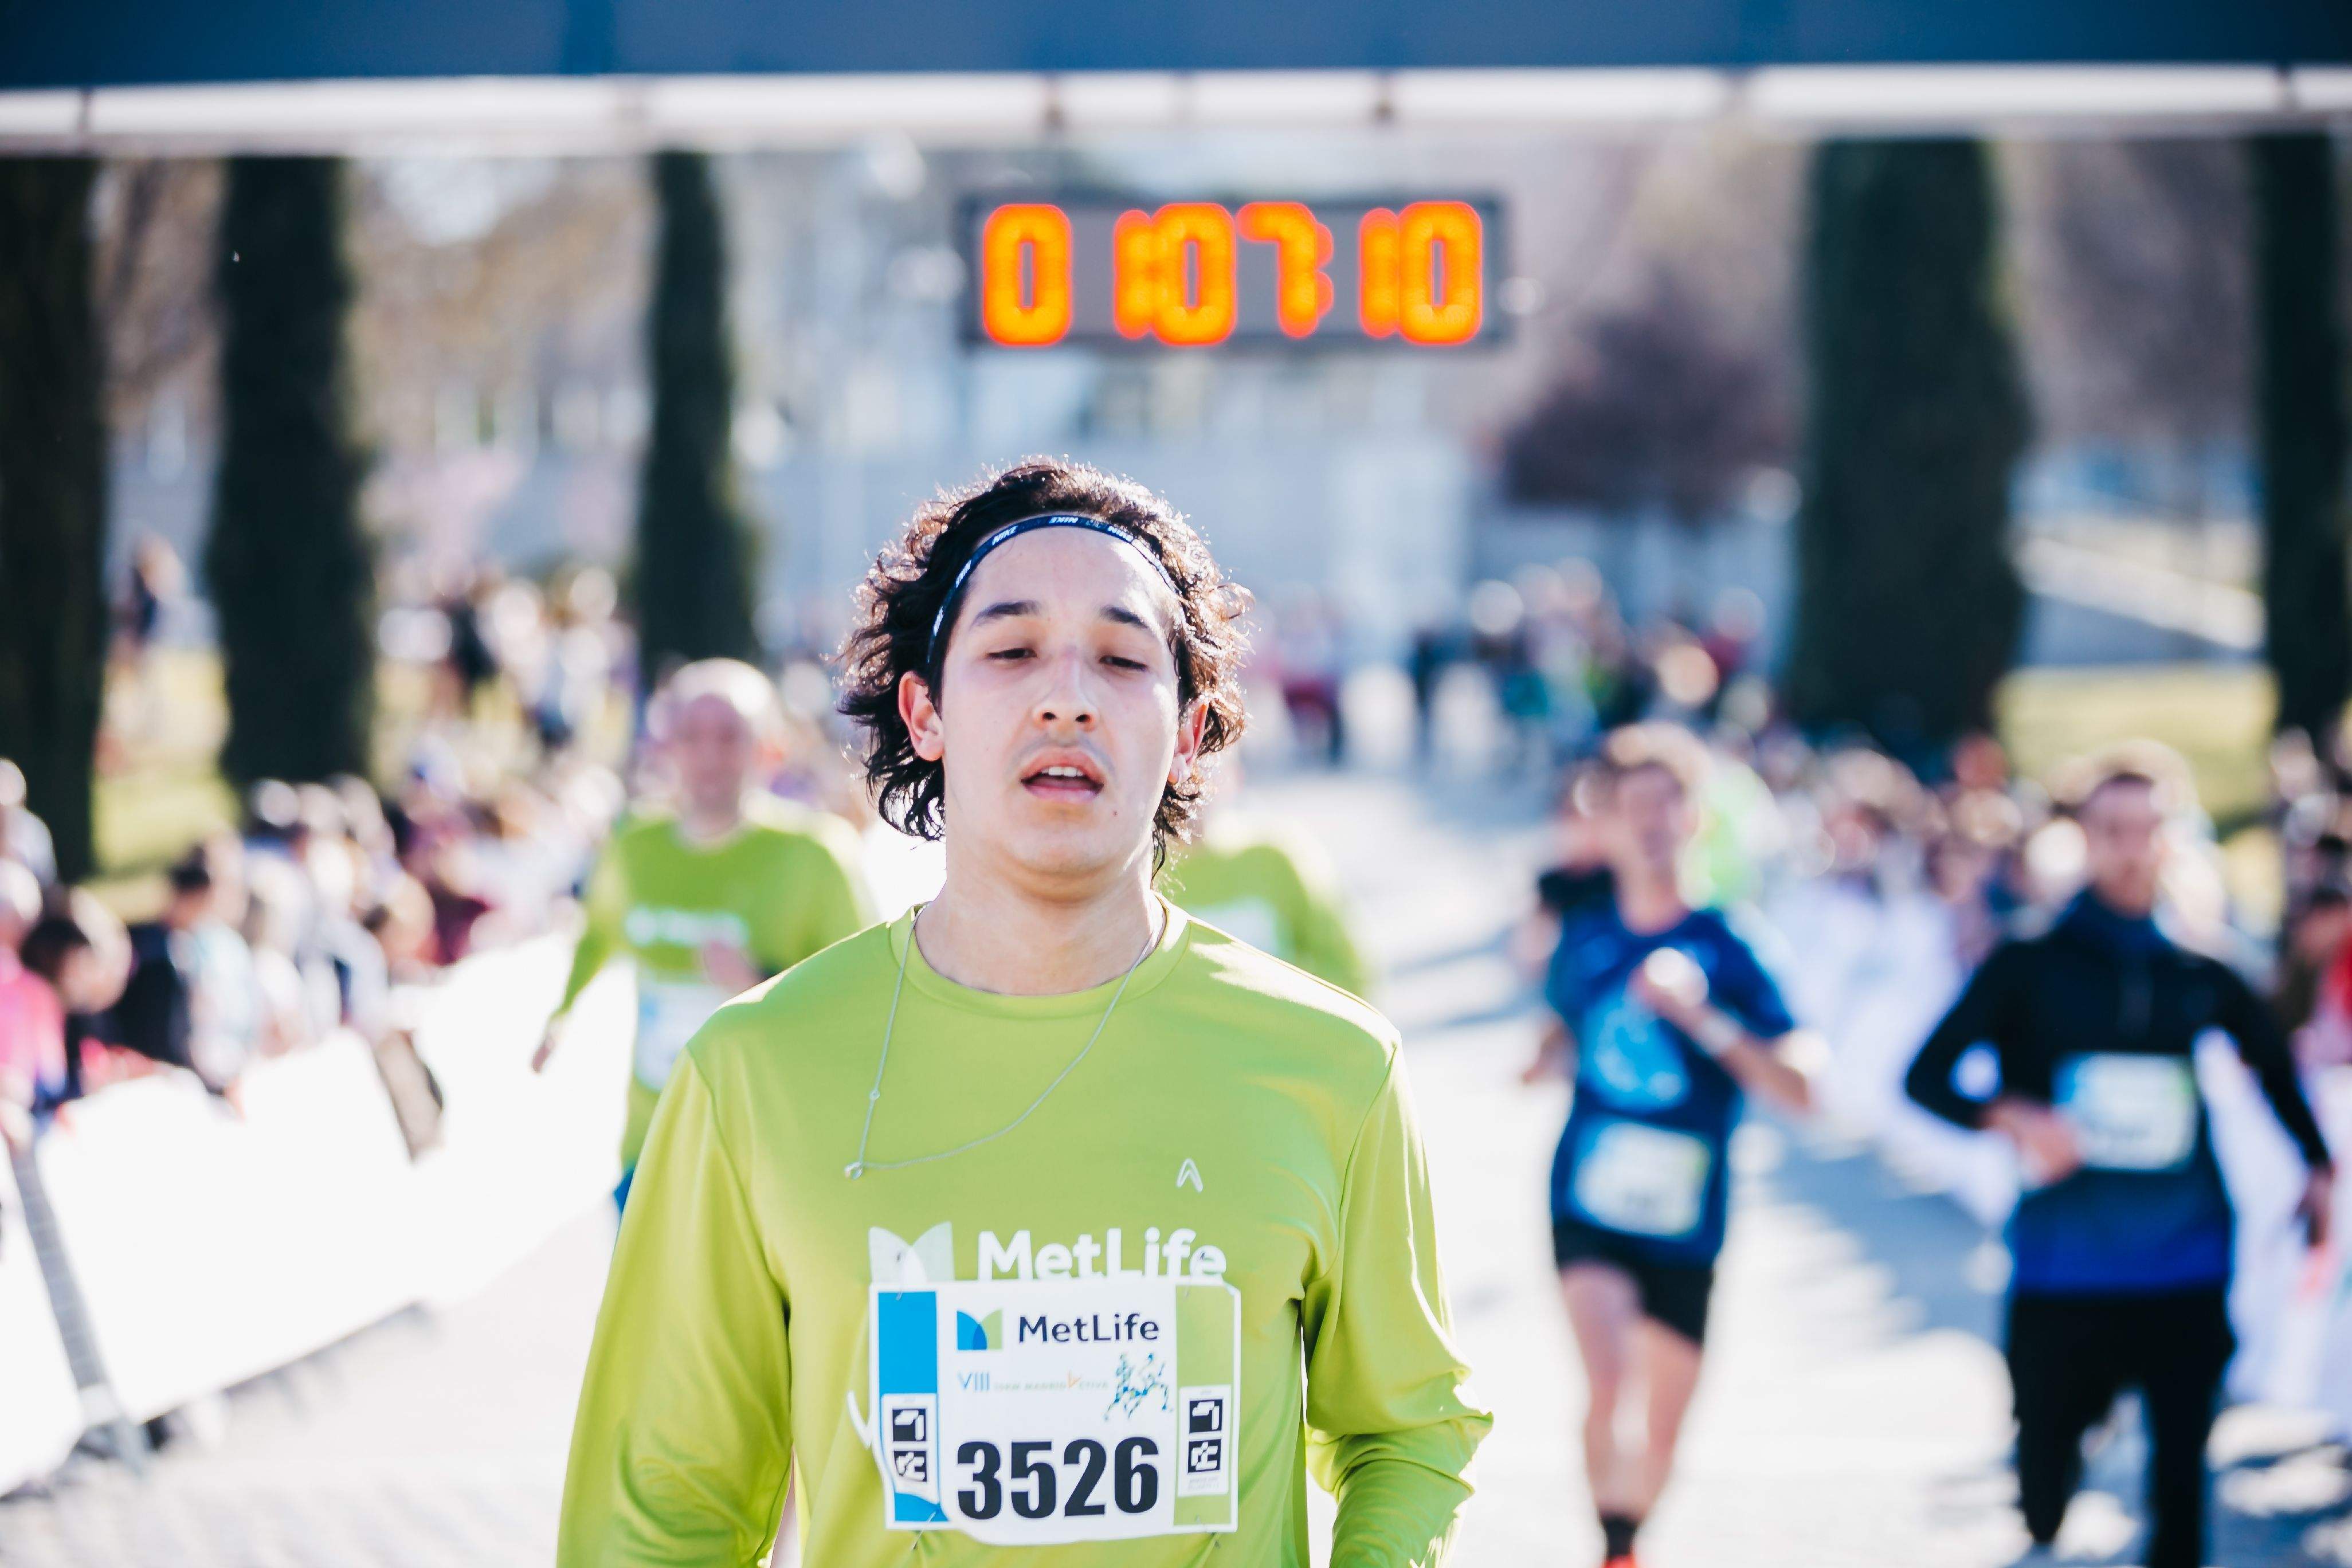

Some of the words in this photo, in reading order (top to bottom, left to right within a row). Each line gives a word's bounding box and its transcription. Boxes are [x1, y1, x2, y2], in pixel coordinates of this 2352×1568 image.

[978, 1227, 1227, 1280] MetLife
[1018, 1313, 1159, 1343] MetLife
[957, 1370, 990, 1391] VIII
[957, 1436, 1159, 1520] 3526
